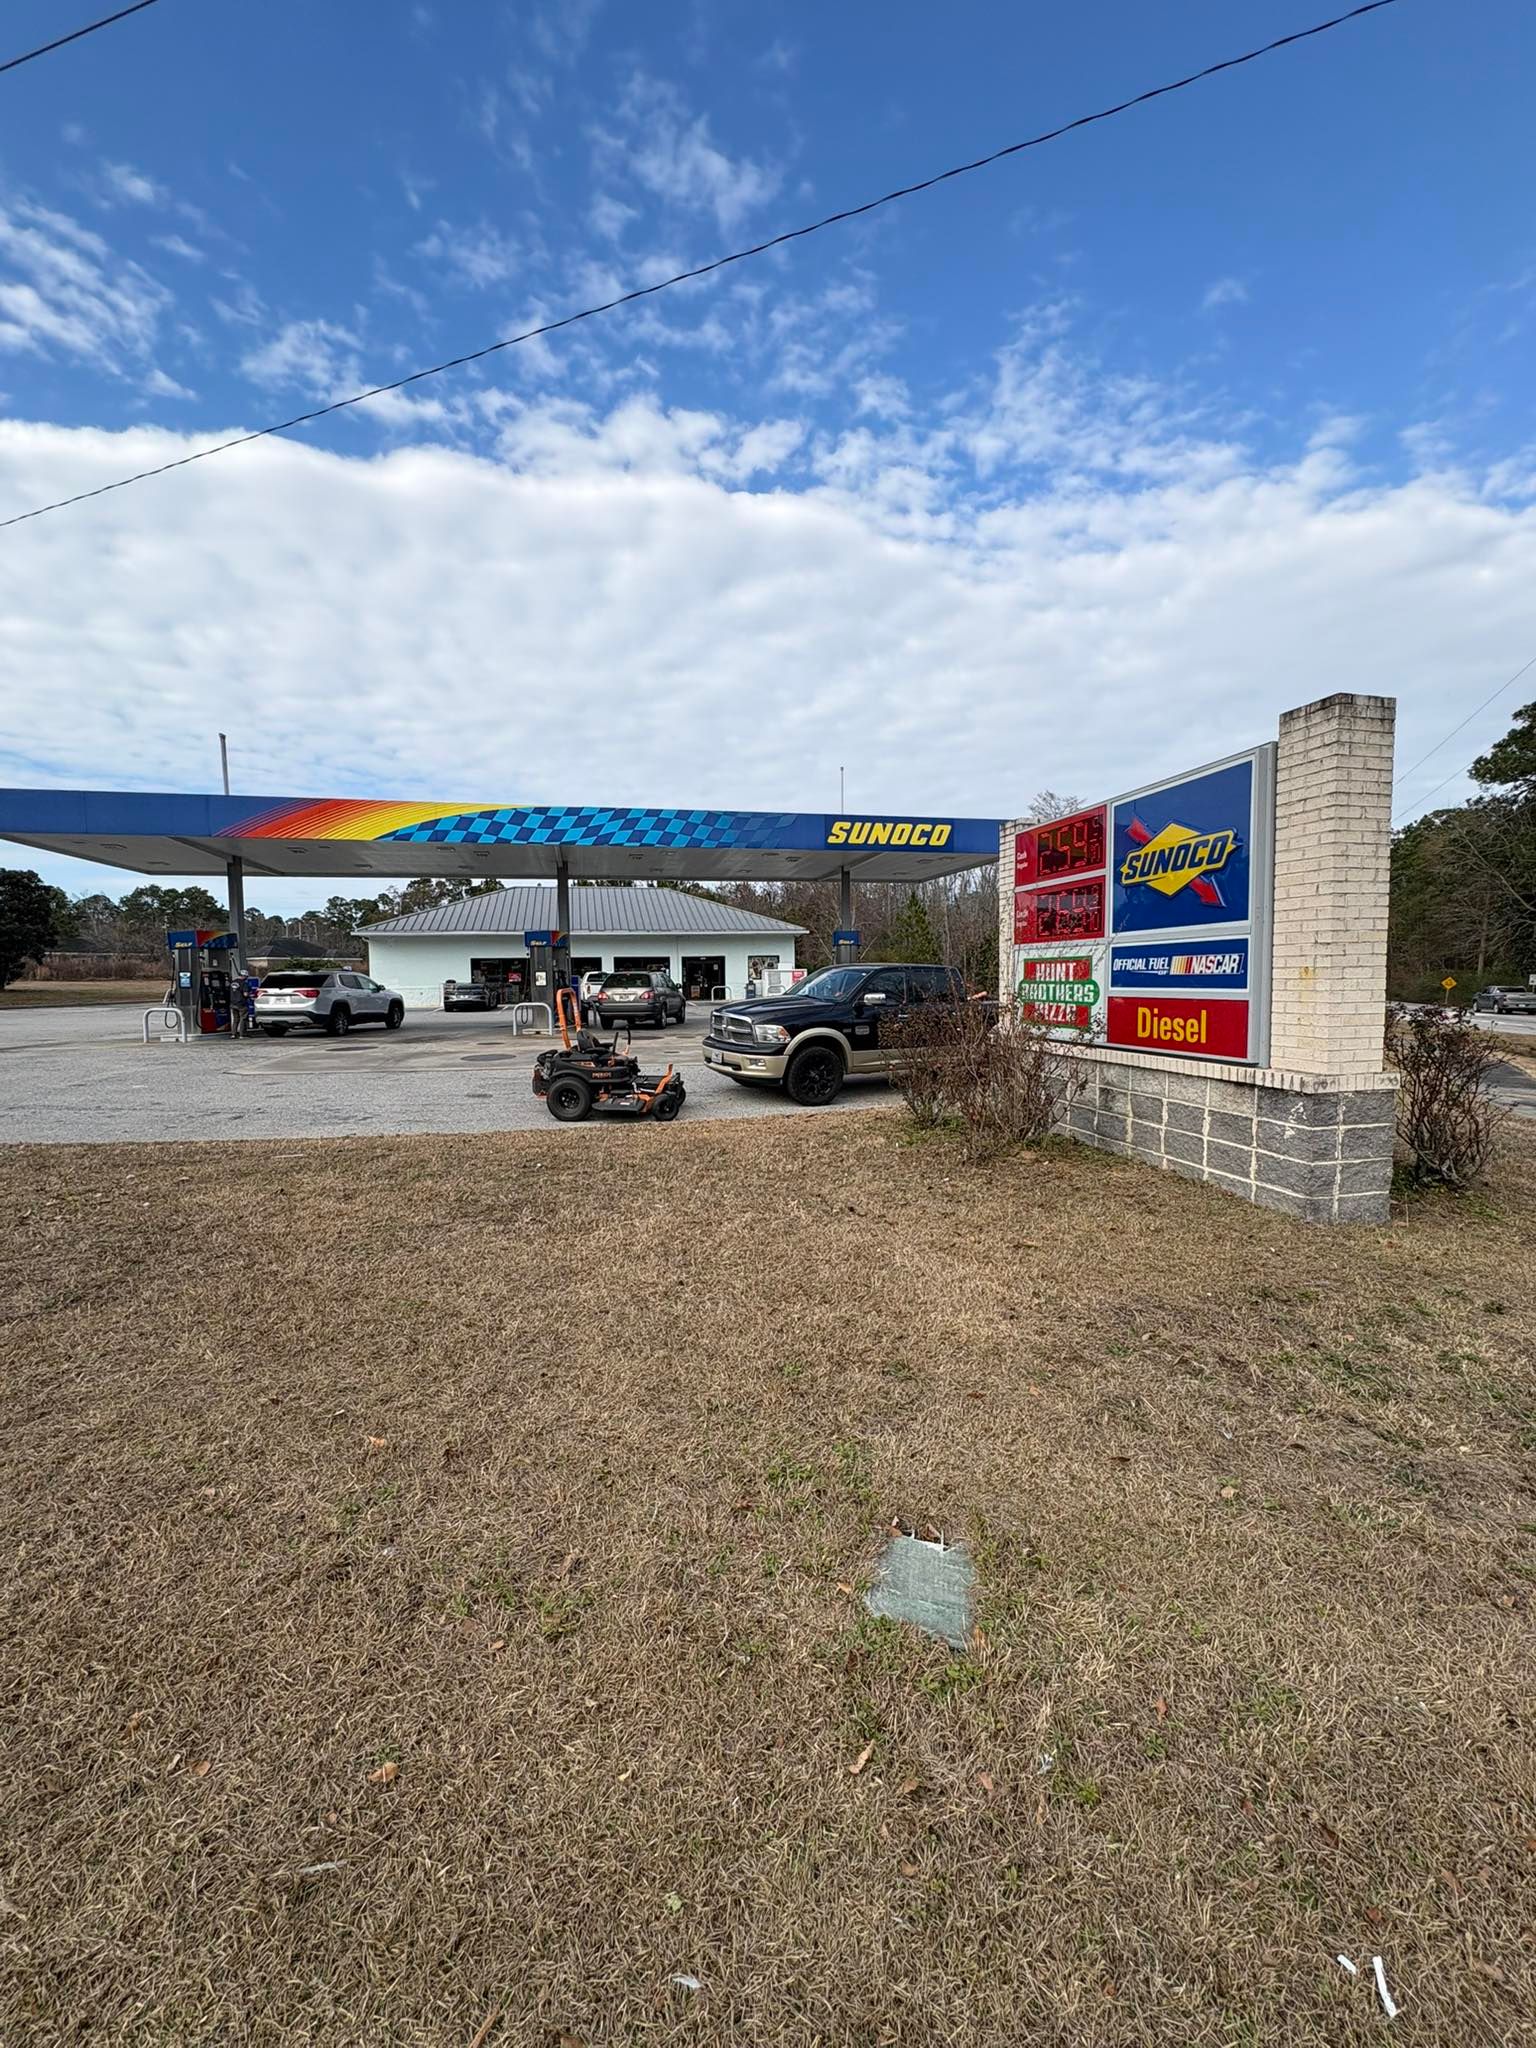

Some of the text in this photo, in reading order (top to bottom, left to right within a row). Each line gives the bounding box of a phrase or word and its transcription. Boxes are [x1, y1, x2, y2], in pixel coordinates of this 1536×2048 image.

[827, 821, 952, 846] SUNOCO
[1123, 834, 1231, 881] SUNOCO
[1035, 962, 1077, 982] HUNT
[1112, 957, 1170, 971] OFFICIAL FUEL
[1190, 954, 1241, 975] NASCAR
[1021, 983, 1096, 1003] BROTHERS
[1137, 1006, 1207, 1044] Diesel
